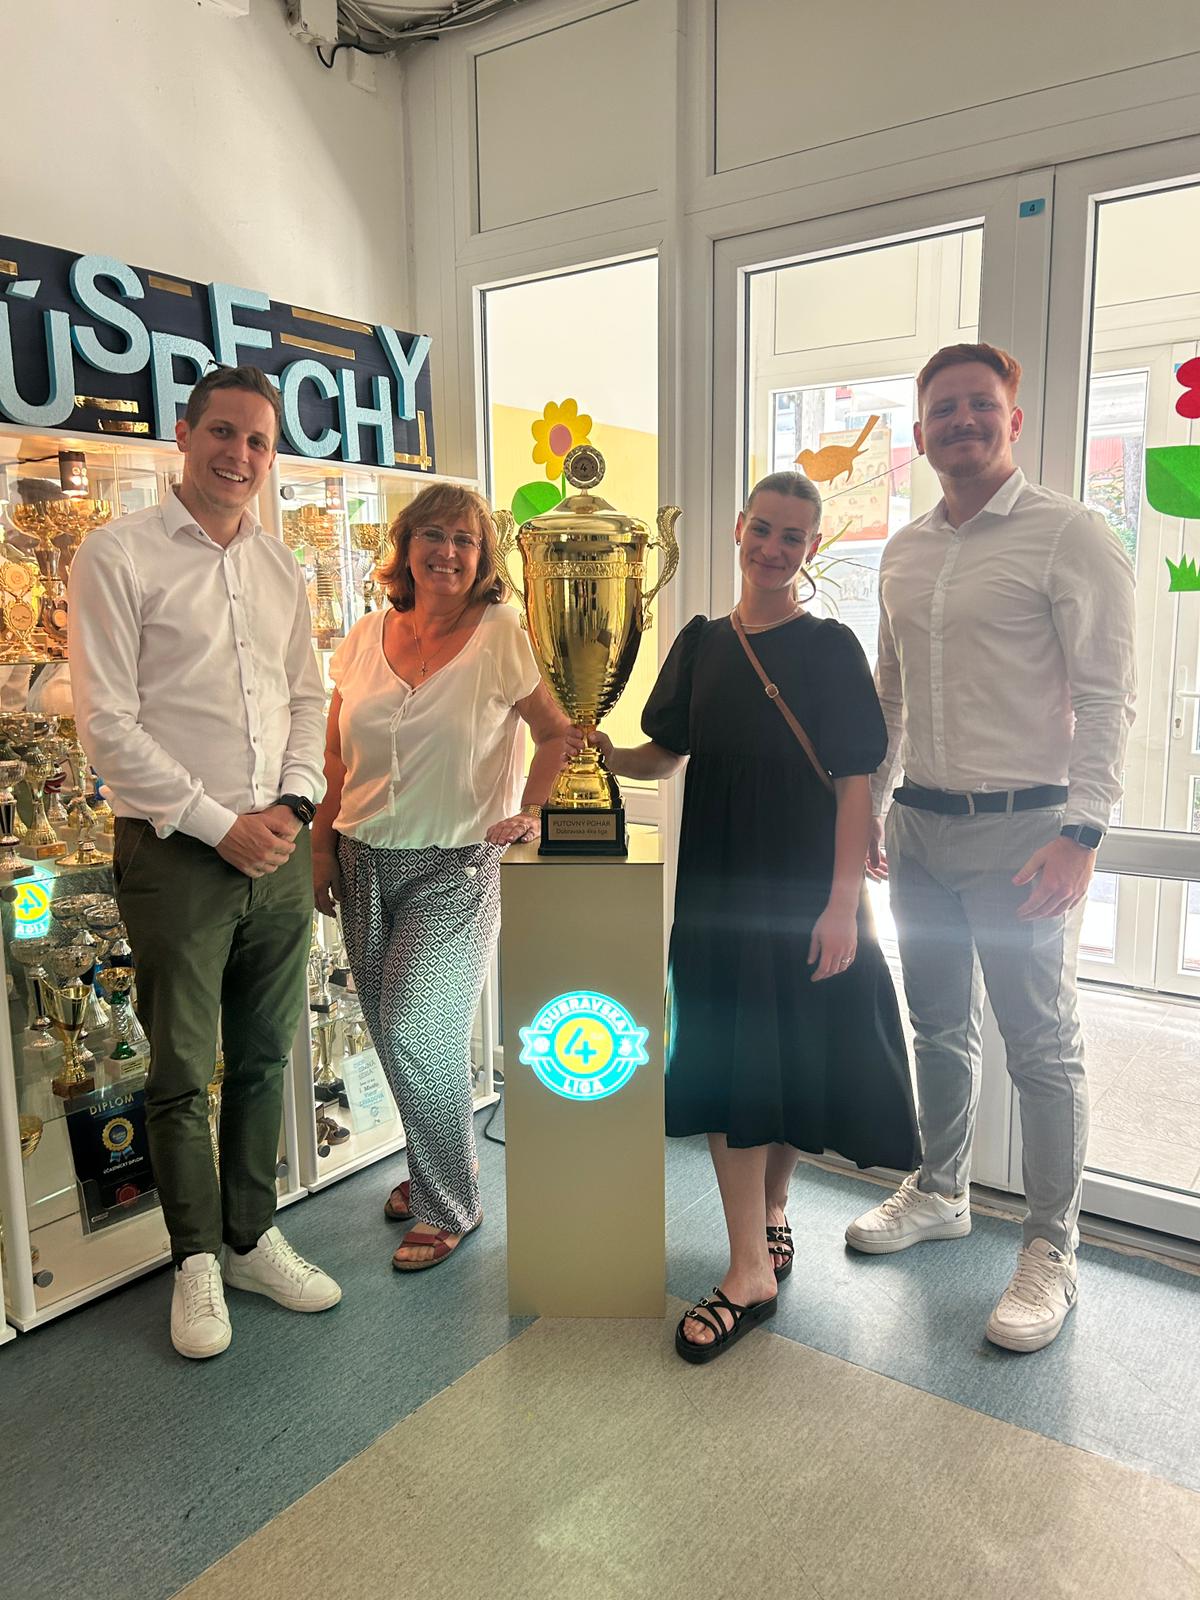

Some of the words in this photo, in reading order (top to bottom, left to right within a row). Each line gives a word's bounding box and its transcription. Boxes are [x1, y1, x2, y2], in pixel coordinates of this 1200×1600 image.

[1029, 203, 1036, 212] 4
[563, 1027, 598, 1065] 4
[562, 1078, 605, 1094] LIGA
[89, 1093, 134, 1115] DIPLOM
